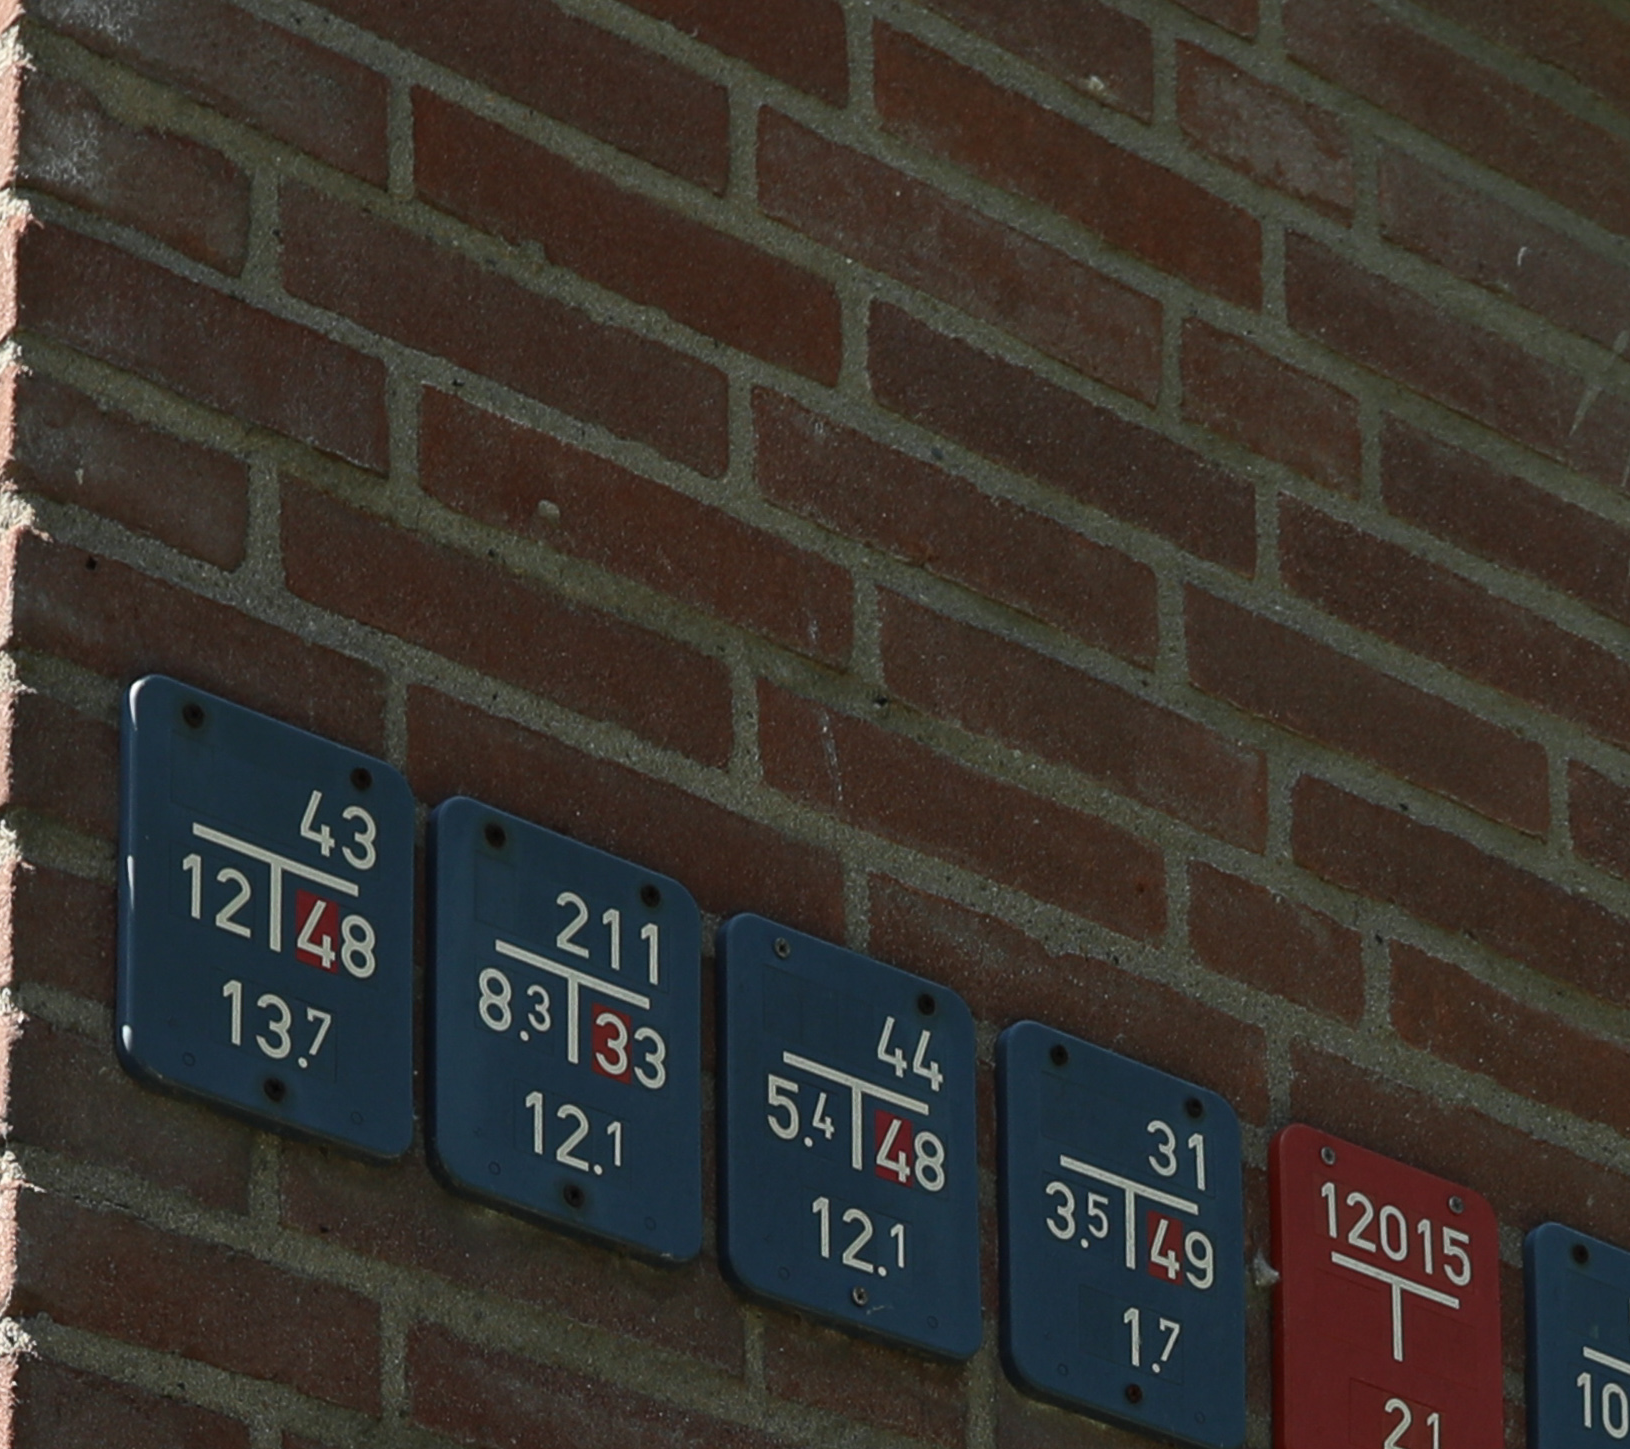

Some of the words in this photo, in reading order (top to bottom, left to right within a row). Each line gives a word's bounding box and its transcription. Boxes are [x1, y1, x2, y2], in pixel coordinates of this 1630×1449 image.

[299, 790, 376, 869] 43
[182, 853, 251, 939] 12
[296, 899, 376, 979] 48
[556, 892, 659, 985] 211
[222, 980, 331, 1069] 13.7
[593, 1012, 666, 1089] 33
[877, 1016, 943, 1091] 44
[525, 1091, 622, 1175] 12.1
[877, 1111, 946, 1193] 48
[1147, 1120, 1206, 1190] 31
[812, 1197, 905, 1277] 12.1
[1150, 1217, 1214, 1289] 49
[1320, 1183, 1471, 1286] 12015
[1577, 1373, 1628, 1437] 10
